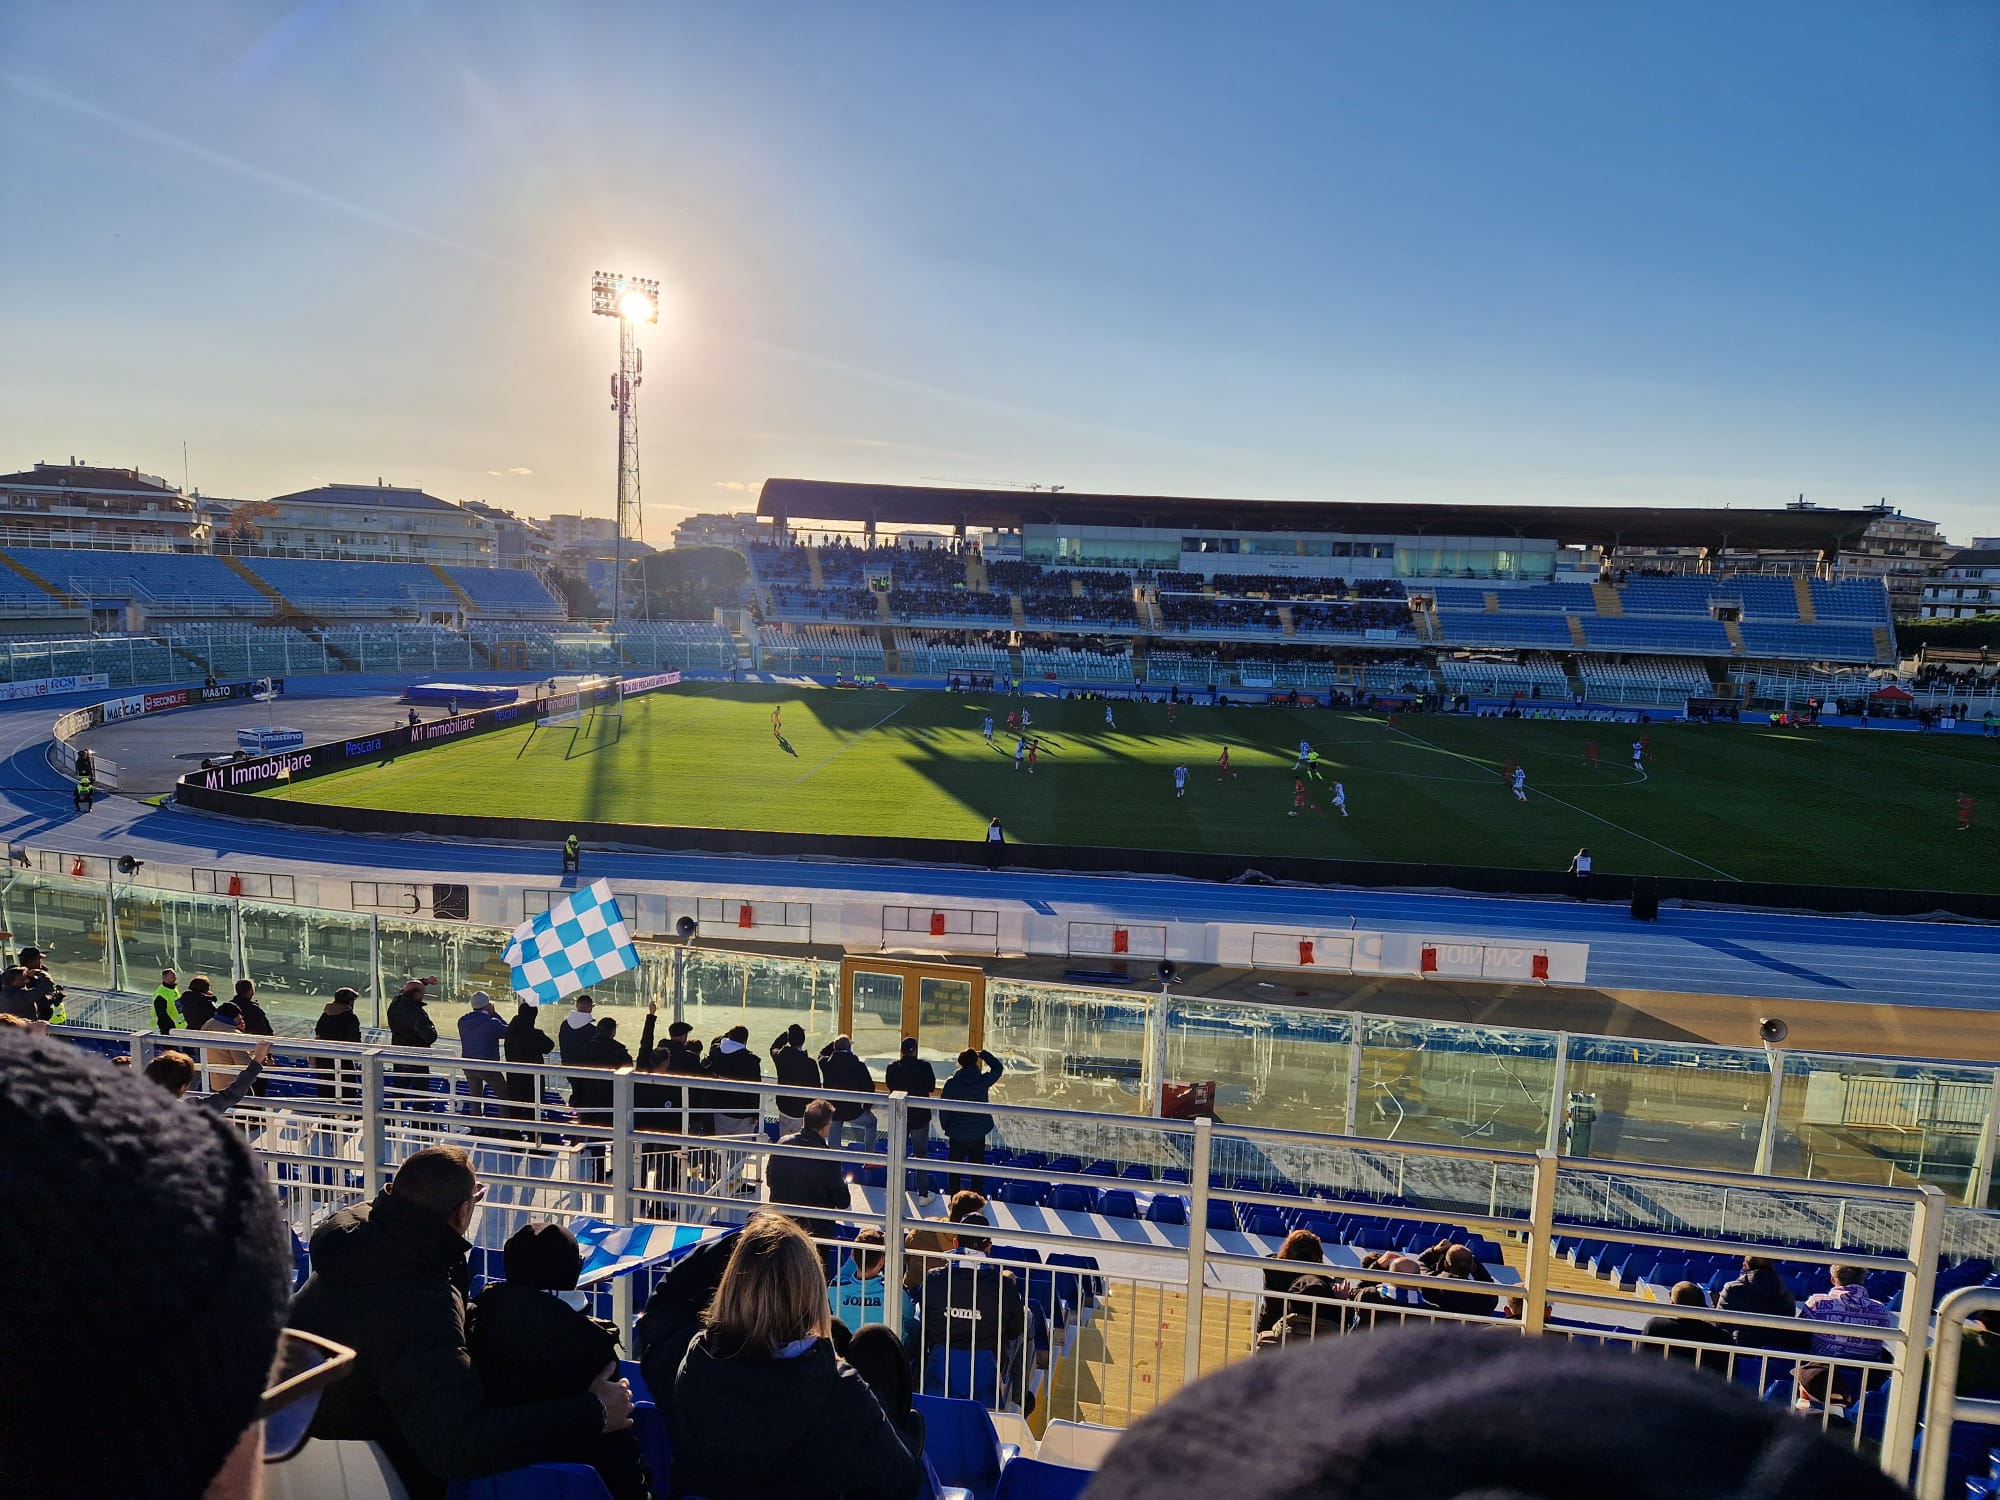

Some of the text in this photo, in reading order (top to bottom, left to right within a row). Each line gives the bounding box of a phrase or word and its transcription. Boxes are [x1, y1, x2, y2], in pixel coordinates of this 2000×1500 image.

[410, 717, 475, 743] M1 Immobiliare
[345, 738, 381, 757] Pescara
[206, 753, 312, 789] M1 Immobiliare
